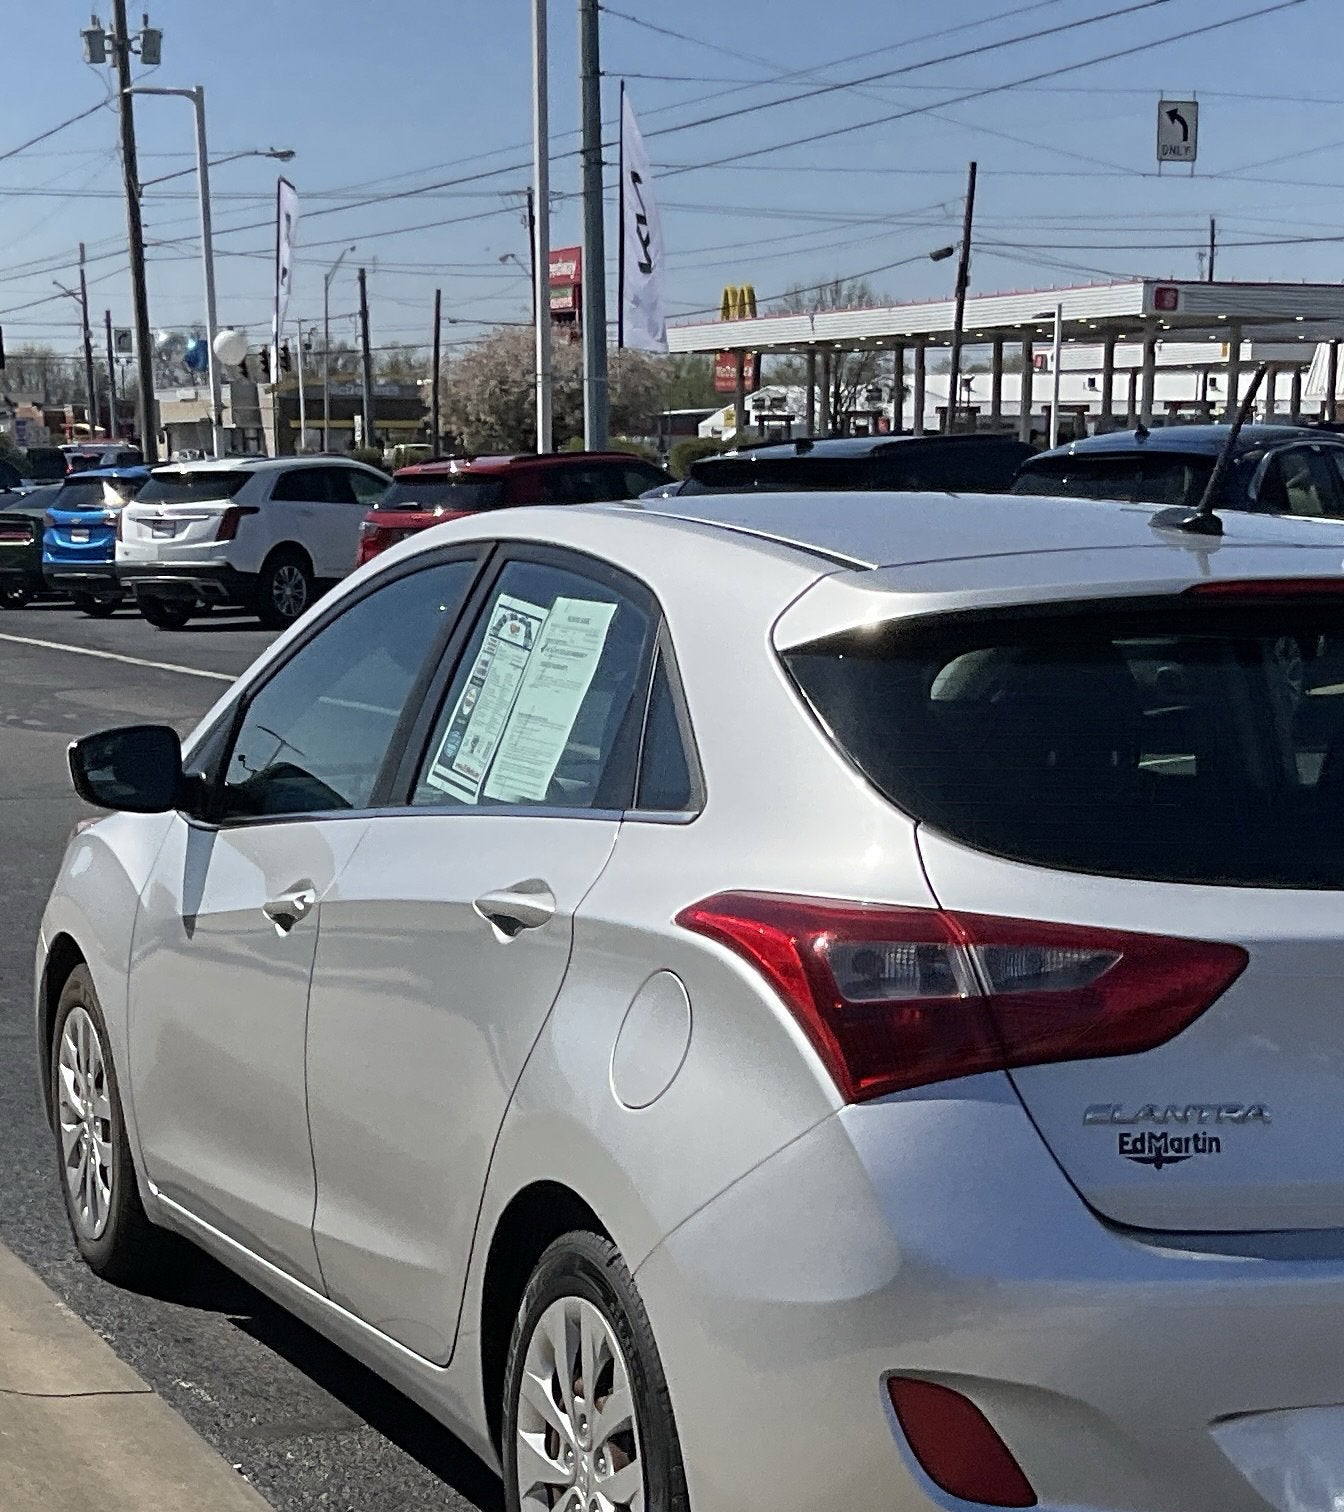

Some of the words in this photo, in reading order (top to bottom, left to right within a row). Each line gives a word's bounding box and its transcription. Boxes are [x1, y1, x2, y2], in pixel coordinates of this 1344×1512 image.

[1161, 144, 1192, 156] ONLY
[1083, 1102, 1272, 1125] ELANTRA
[1119, 1131, 1221, 1155] EdMartin
